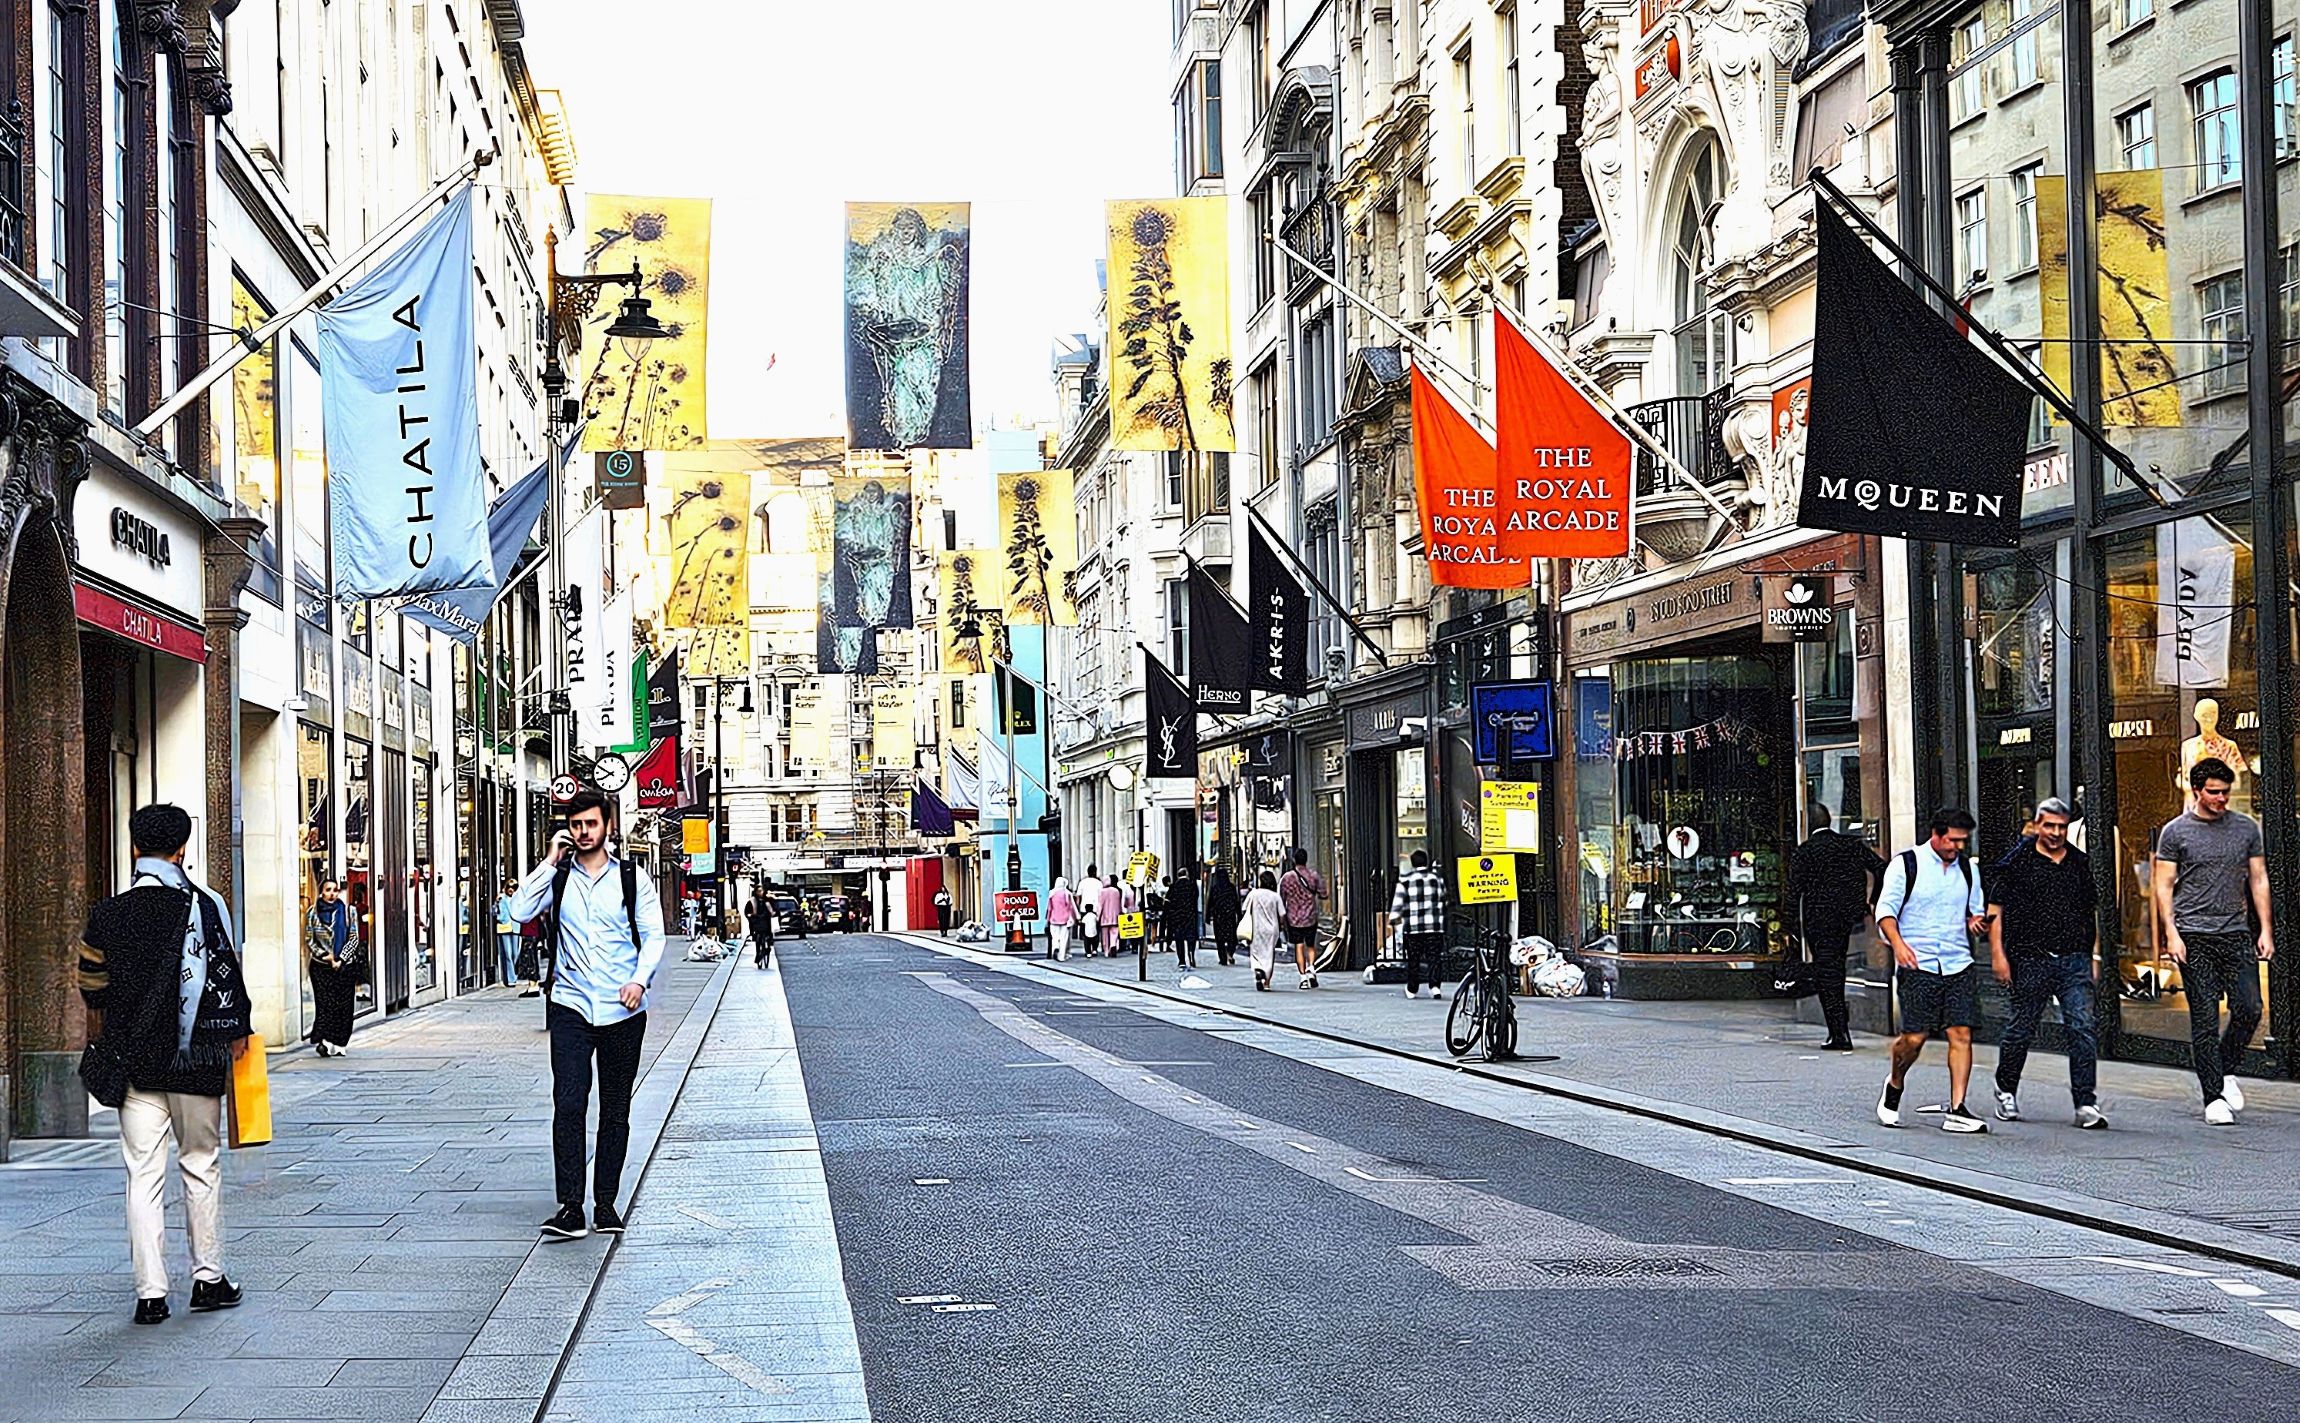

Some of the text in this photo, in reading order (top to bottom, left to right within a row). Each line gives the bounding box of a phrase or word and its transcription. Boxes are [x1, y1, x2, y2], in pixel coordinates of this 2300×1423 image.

[392, 294, 434, 570] CHATILA
[613, 458, 628, 470] 15
[1534, 447, 1593, 468] THE
[1443, 488, 1496, 507] THE
[1516, 479, 1612, 499] ROYAL
[1432, 516, 1497, 536] ROYA
[1506, 510, 1619, 531] ARCADE
[111, 506, 172, 567] CHATILA
[1700, 581, 1733, 609] STREET
[411, 594, 480, 635] MaxMara
[1767, 607, 1832, 625] BROWNS
[123, 608, 162, 645] CHATILA
[564, 585, 585, 684] PRAD
[1004, 720, 1032, 728] LEX
[555, 782, 575, 795] 20
[1467, 878, 1509, 888] WARNING
[1003, 895, 1029, 905] ROAD
[199, 1017, 239, 1029] UITTON
